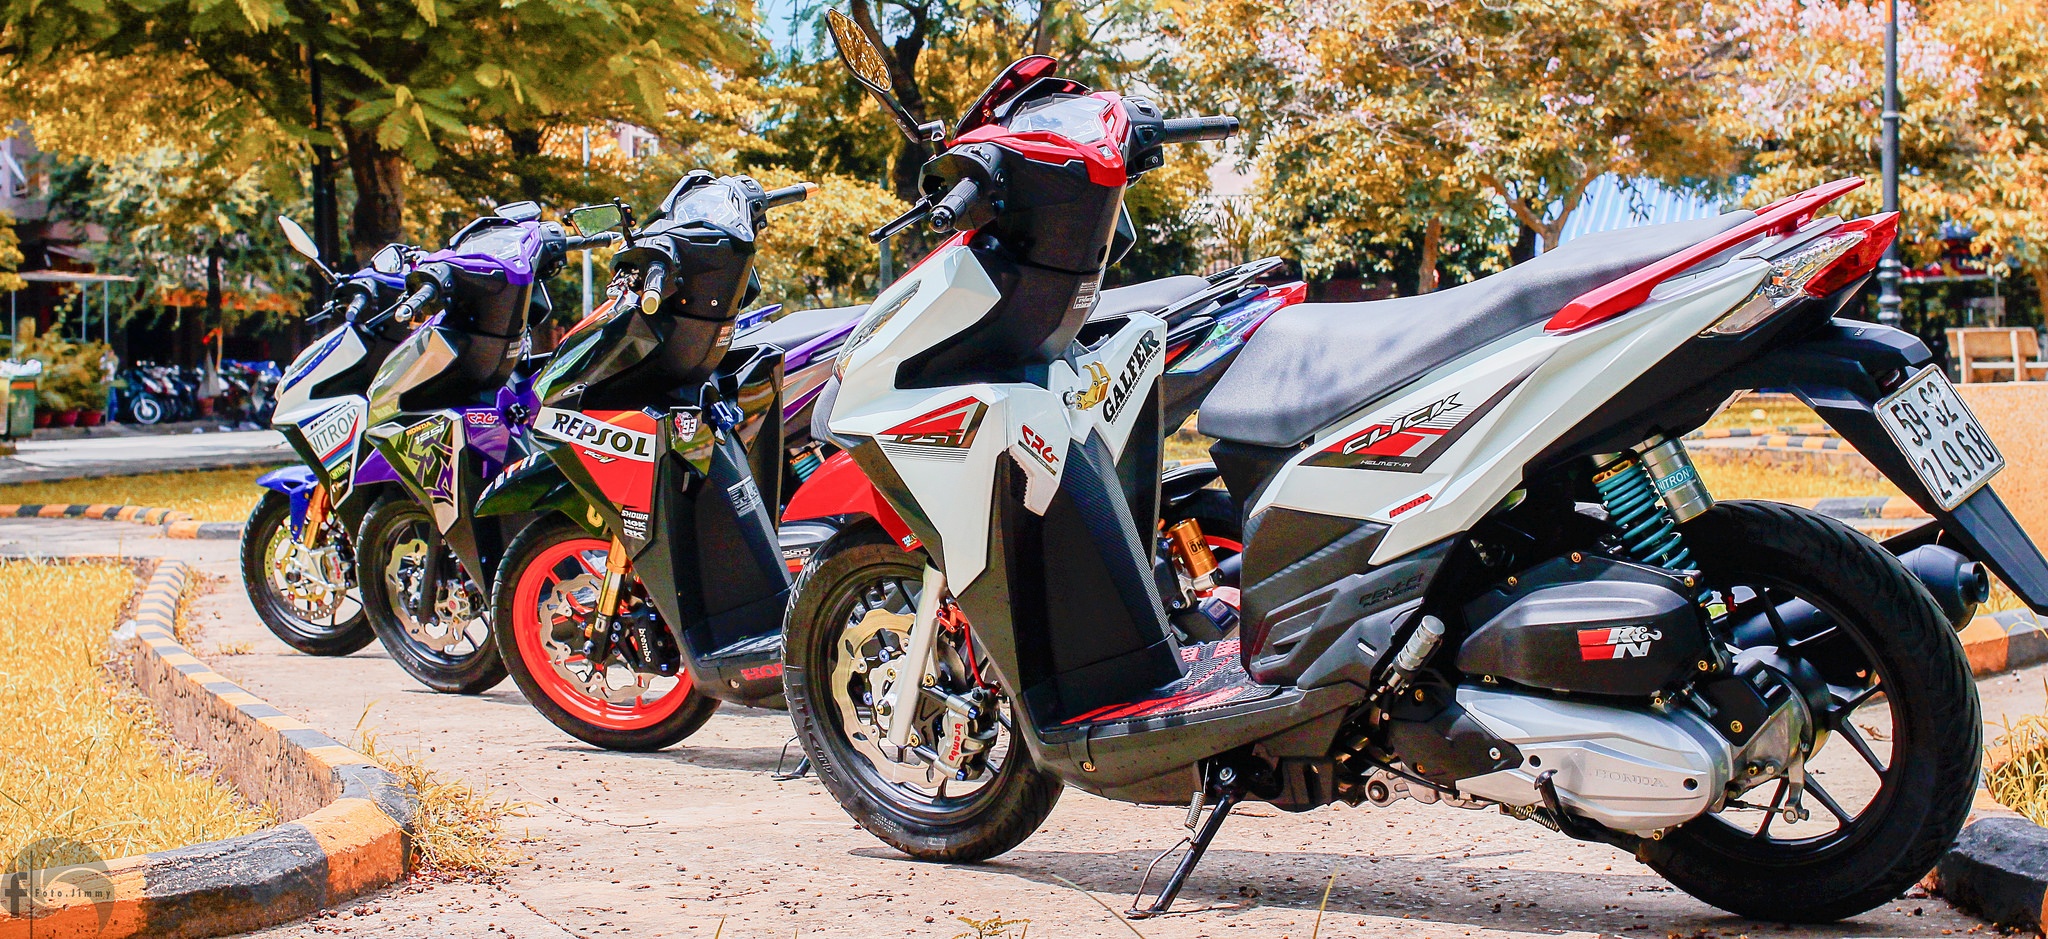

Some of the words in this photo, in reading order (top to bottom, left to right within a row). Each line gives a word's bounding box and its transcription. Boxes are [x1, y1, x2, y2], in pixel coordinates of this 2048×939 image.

[1102, 329, 1161, 423] GALFER
[405, 420, 433, 437] HONDA
[552, 412, 650, 457] REPSOL
[682, 418, 698, 434] 93
[1342, 391, 1464, 456] CLICK
[1360, 459, 1412, 468] HELMET-IN
[1919, 422, 1995, 500] 249.68
[1657, 468, 1691, 491] NITRON
[621, 509, 649, 521] SHOWA
[1388, 493, 1433, 519] HONDA
[638, 627, 652, 663] brembo
[948, 722, 964, 761] brembo
[1594, 768, 1669, 788] HONDA
